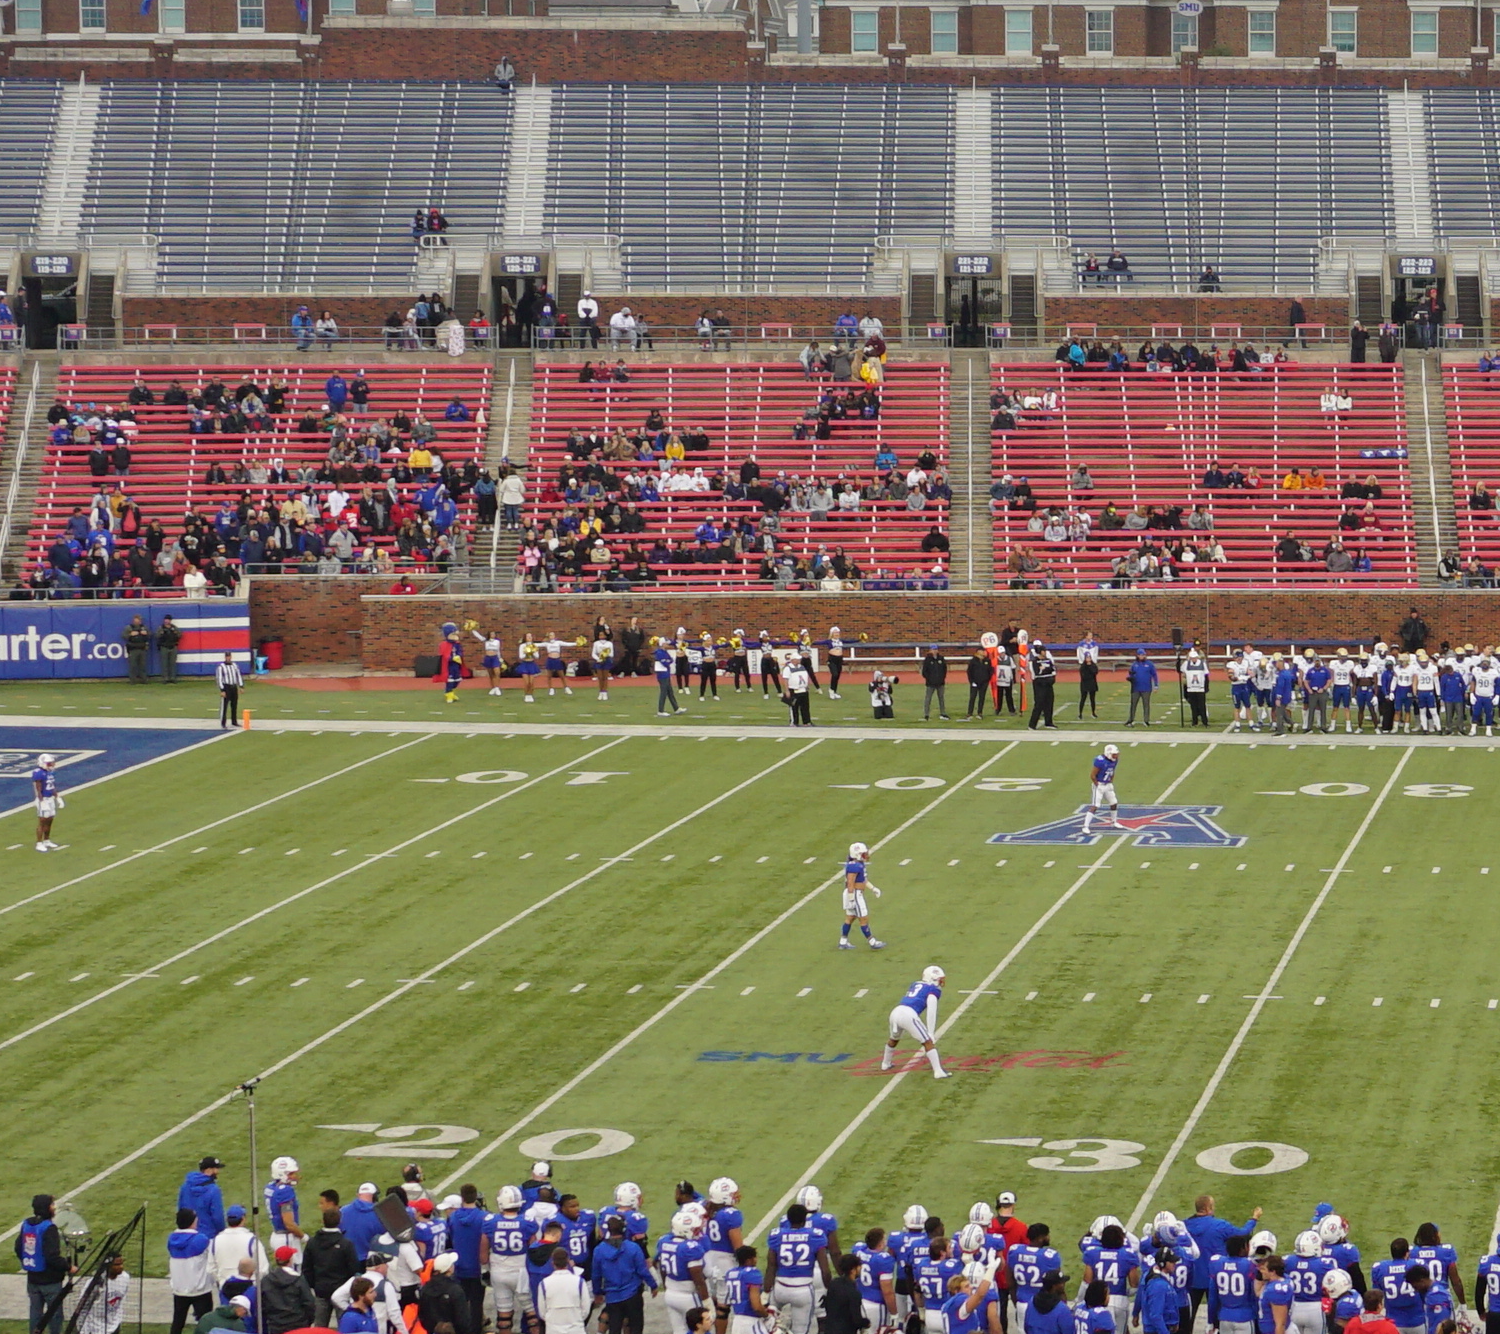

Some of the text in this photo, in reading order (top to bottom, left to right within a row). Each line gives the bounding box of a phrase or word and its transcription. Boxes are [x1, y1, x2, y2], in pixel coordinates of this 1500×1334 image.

[1178, 2, 1200, 12] SMU
[696, 1050, 854, 1063] SMU
[345, 1123, 635, 1161] 20
[1027, 1137, 1310, 1175] 30
[432, 1232, 448, 1256] 18
[492, 1229, 524, 1253] 56
[569, 1235, 588, 1256] 91
[660, 1253, 678, 1276] 51
[779, 1244, 811, 1267] 52
[1013, 1264, 1044, 1287] 62
[1094, 1262, 1120, 1286] 14
[1217, 1271, 1245, 1296] 90
[1290, 1272, 1317, 1295] 33
[919, 1277, 943, 1299] 67
[1384, 1275, 1416, 1299] 54
